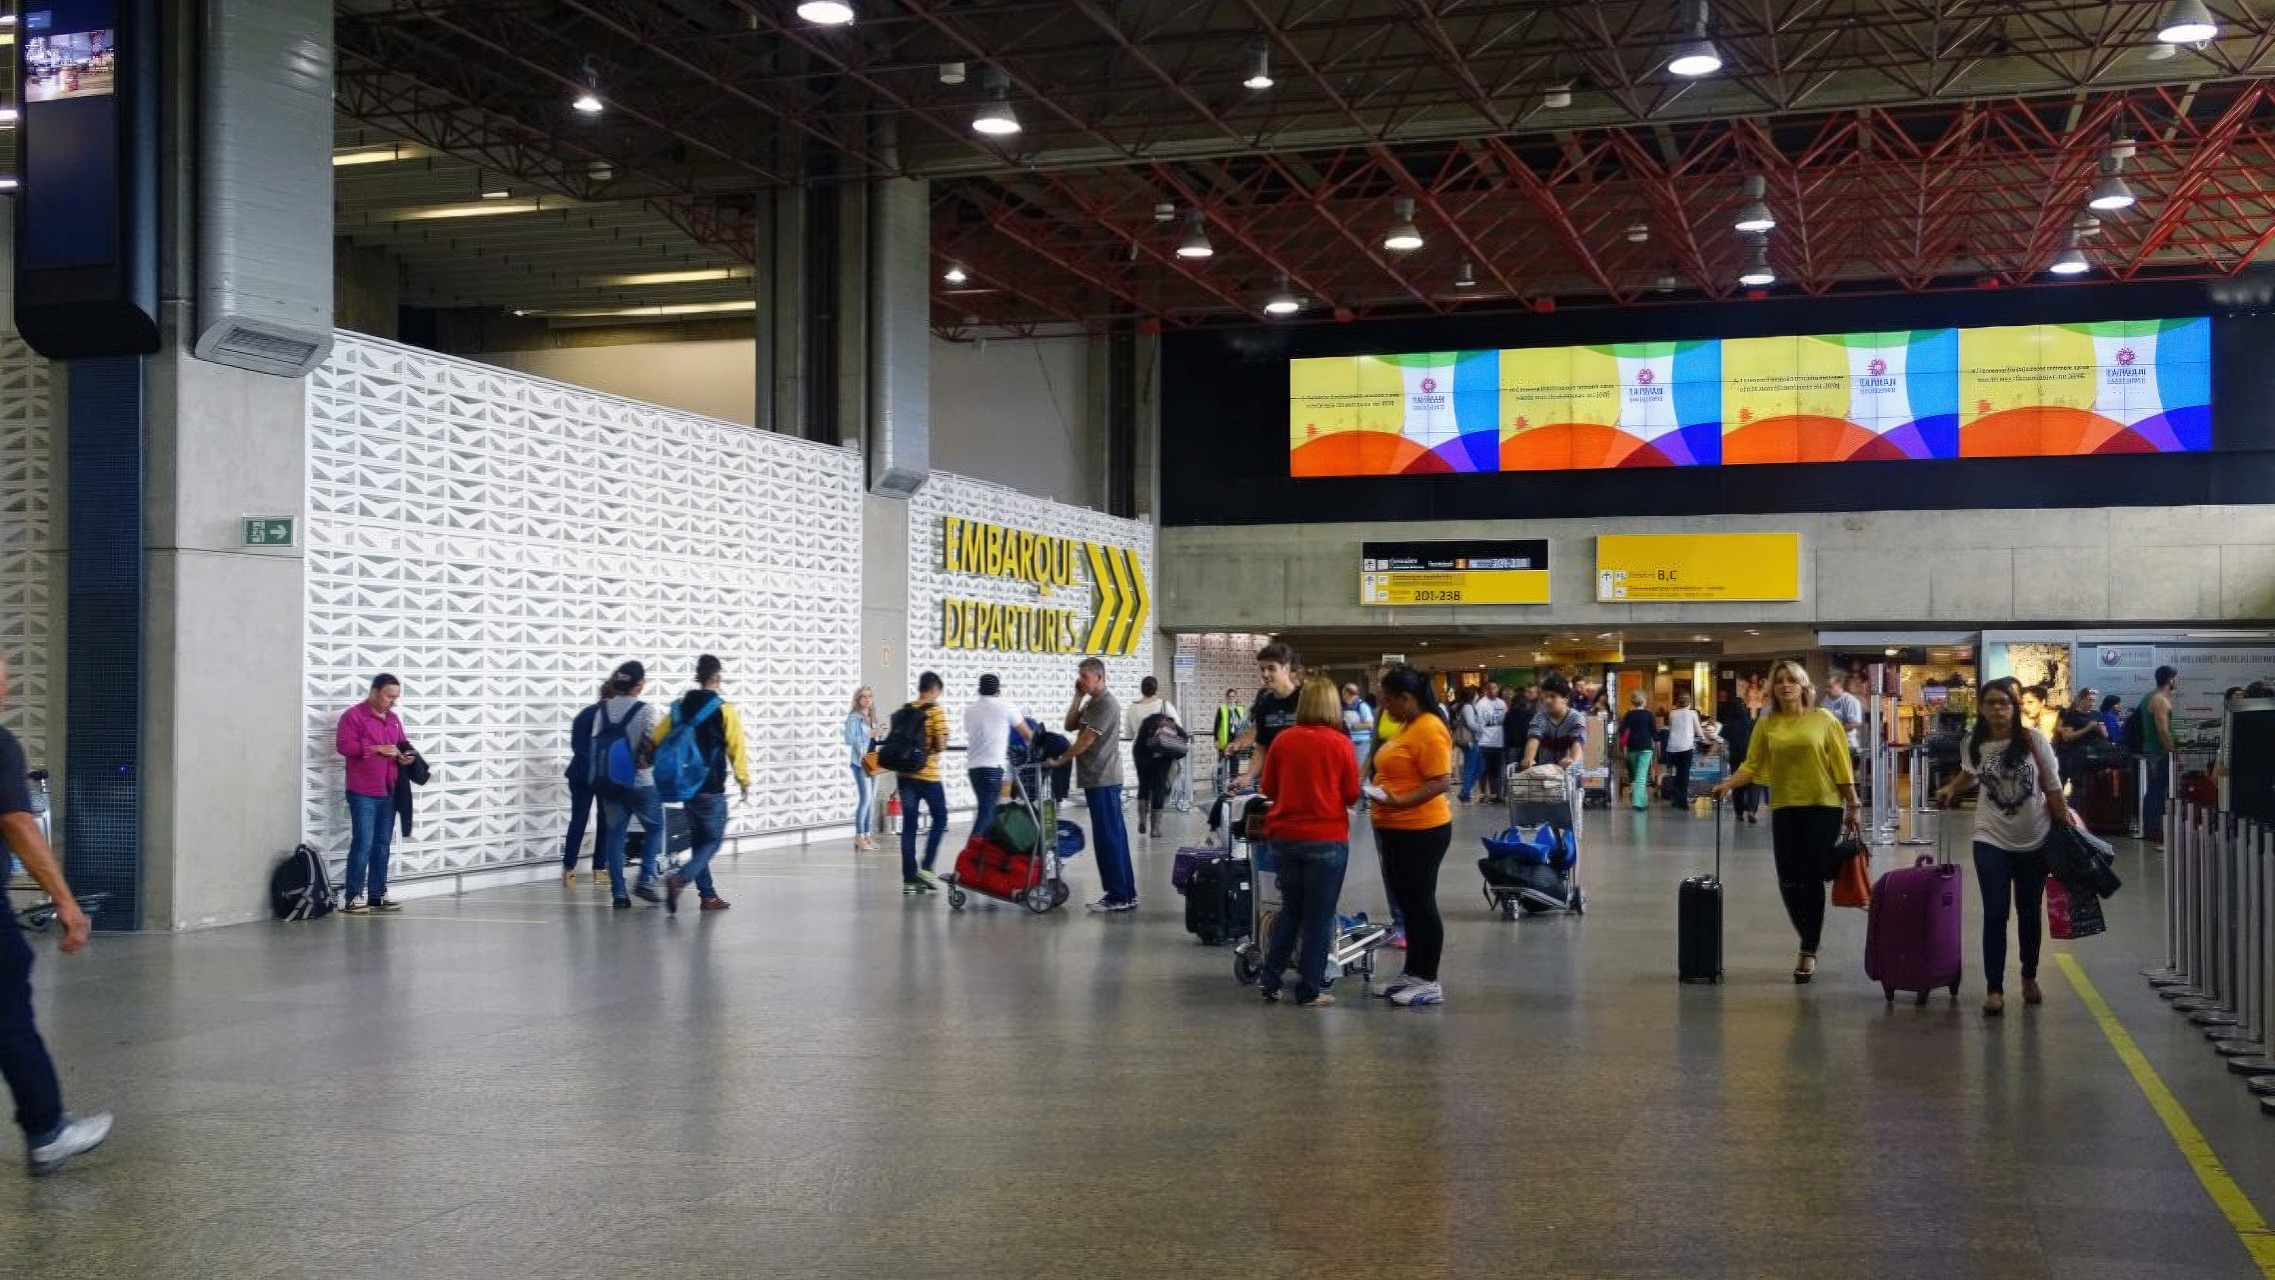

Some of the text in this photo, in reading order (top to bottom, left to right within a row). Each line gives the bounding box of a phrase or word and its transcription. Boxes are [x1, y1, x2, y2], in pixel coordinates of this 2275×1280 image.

[945, 517, 1078, 595] EMBARQUE
[1415, 590, 1460, 601] 201-238
[945, 598, 1077, 653] DEPARTURES
